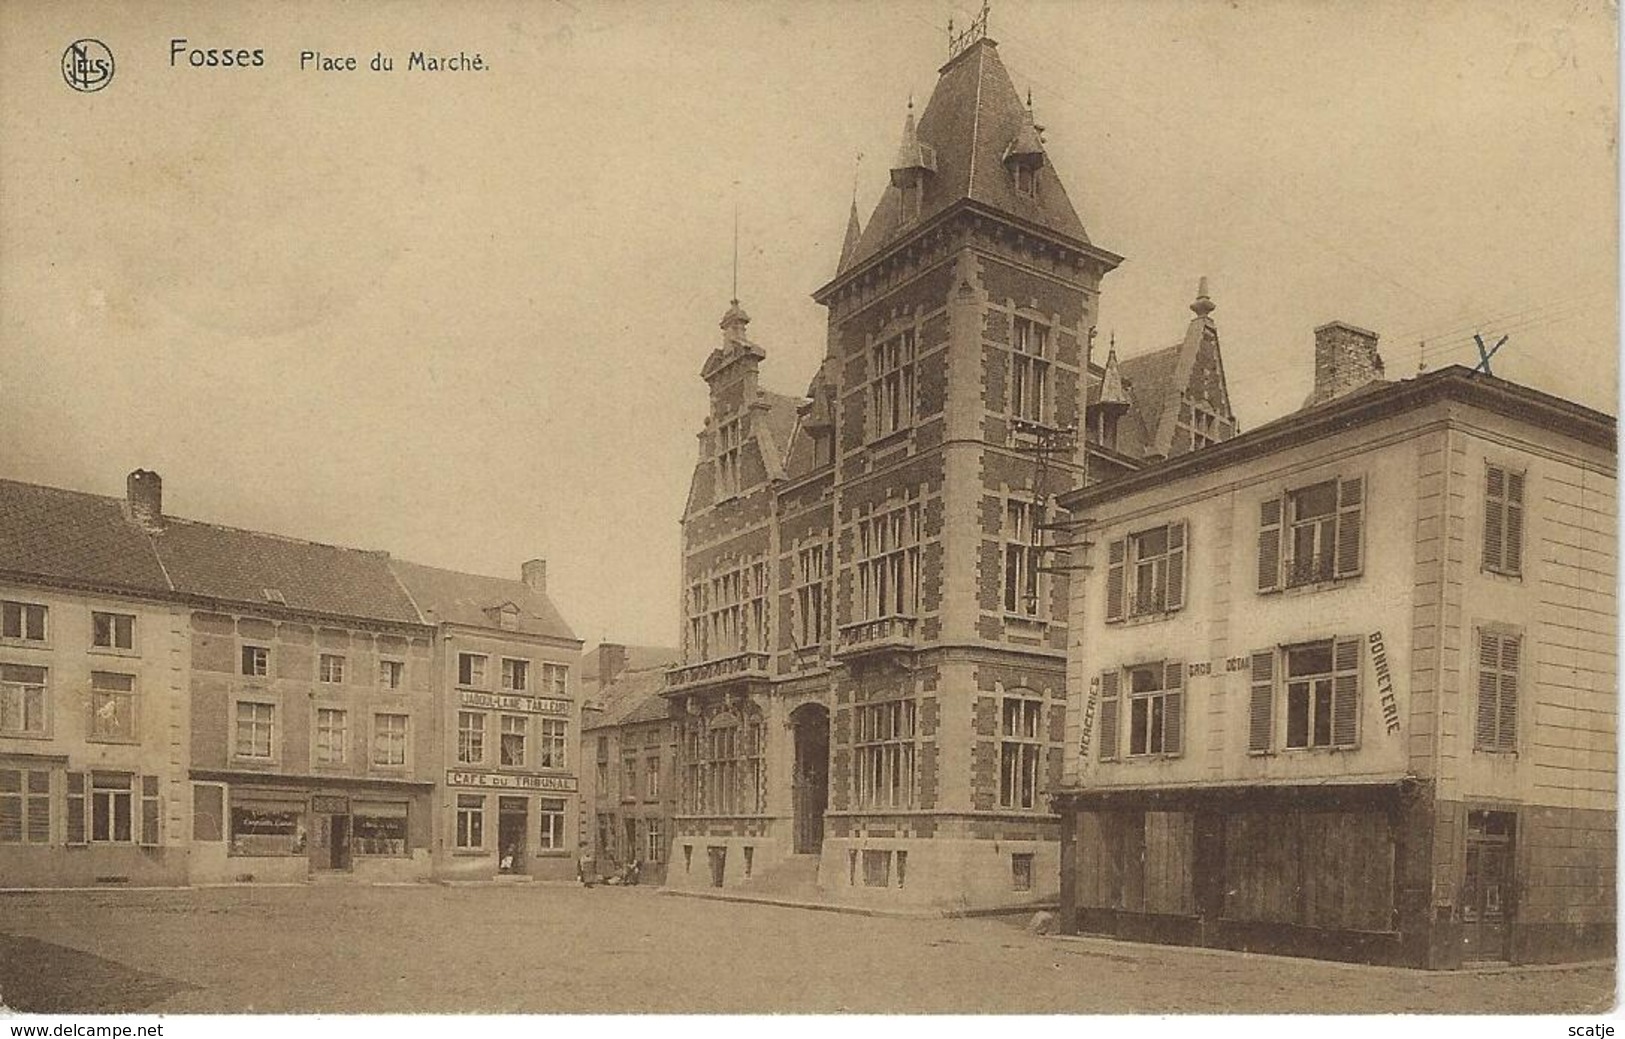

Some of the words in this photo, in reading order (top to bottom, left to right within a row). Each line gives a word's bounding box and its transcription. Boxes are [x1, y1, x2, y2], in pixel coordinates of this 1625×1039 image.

[1079, 676, 1100, 757] MERCERIES
[1368, 630, 1400, 737] BONNETERIE
[514, 777, 571, 789] TRIBUNAL
